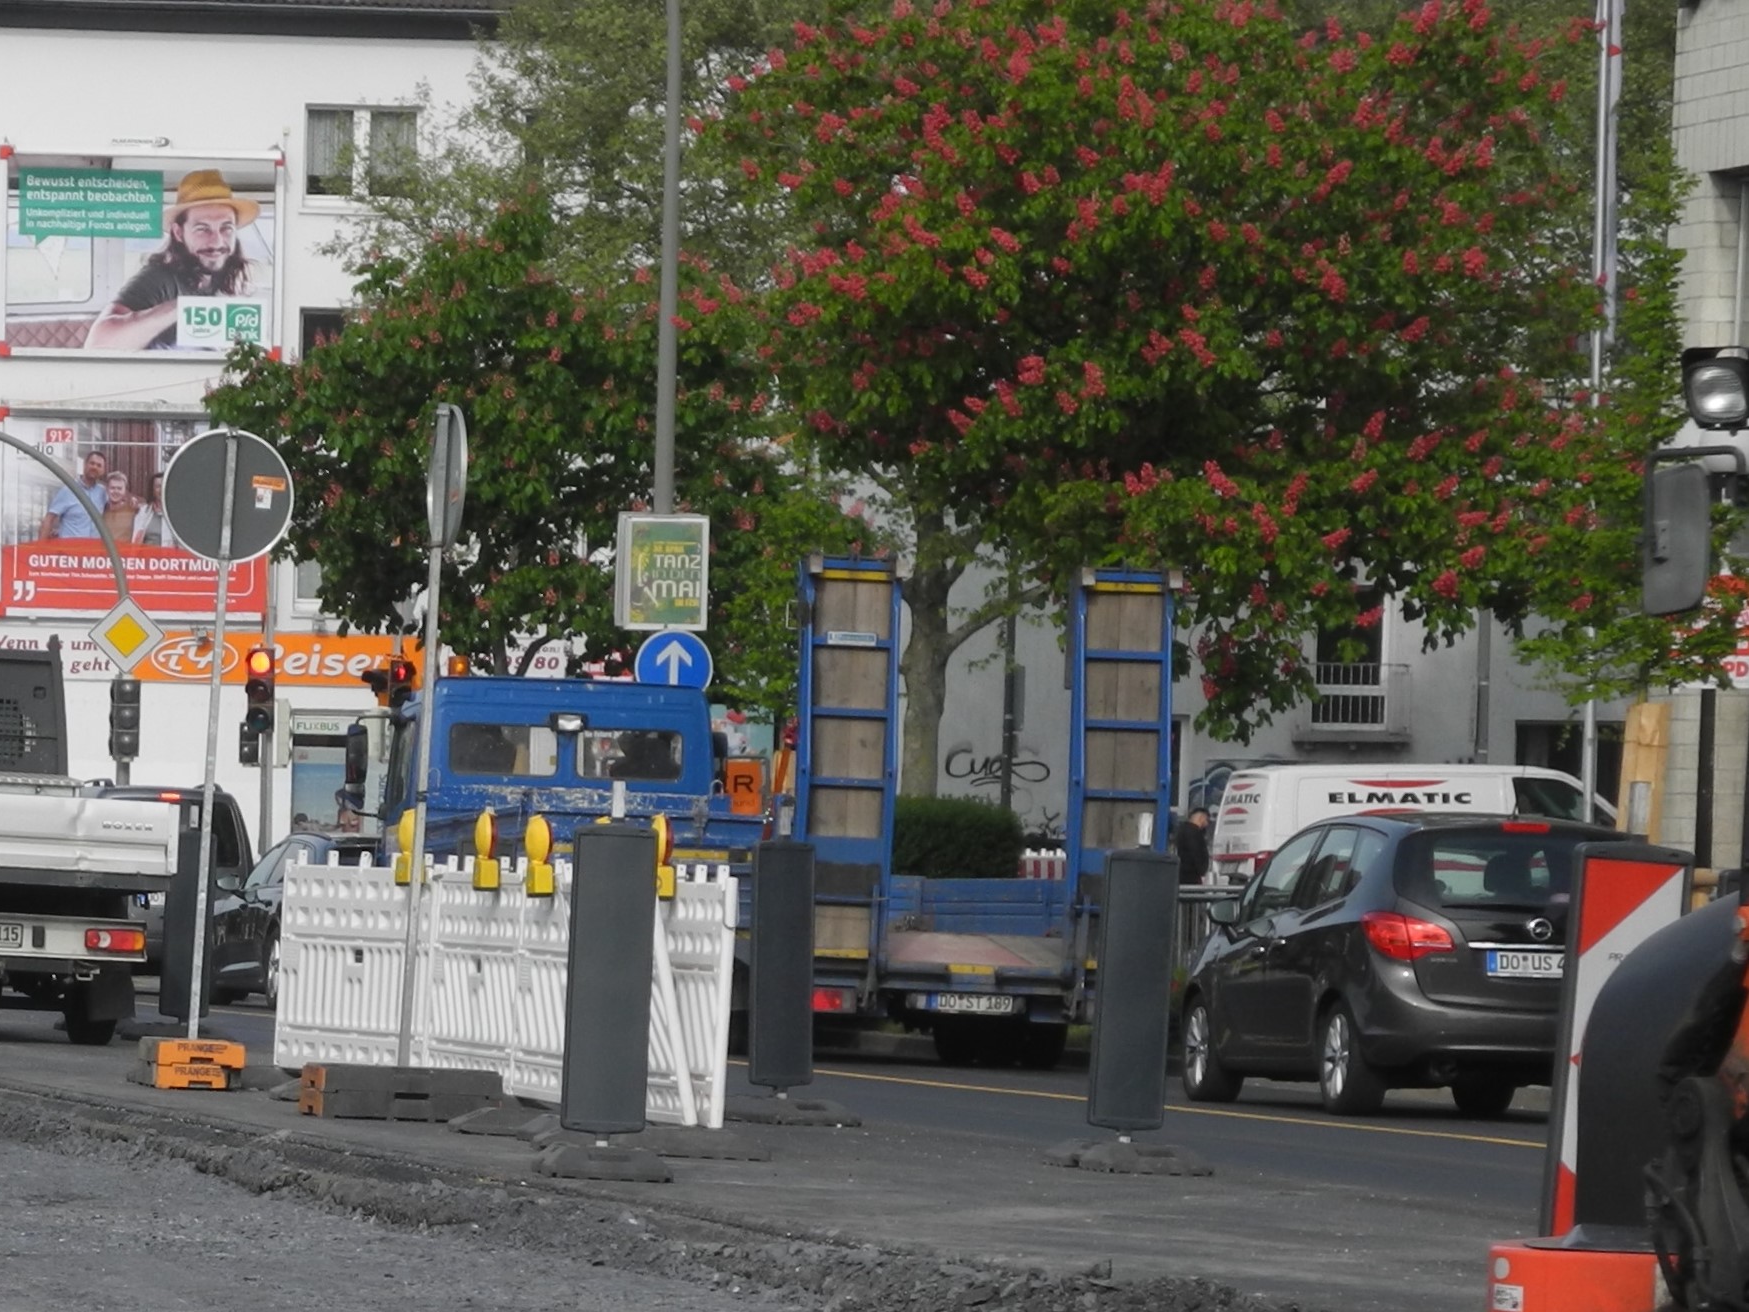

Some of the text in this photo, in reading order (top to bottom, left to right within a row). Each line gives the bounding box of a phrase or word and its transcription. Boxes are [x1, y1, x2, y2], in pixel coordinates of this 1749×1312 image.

[26, 174, 150, 190] Bewusst entscheiden,
[26, 188, 156, 203] entspannt beobachten.
[183, 306, 223, 327] 150
[28, 554, 78, 568] GUTEN
[654, 554, 701, 569] TANZ
[651, 580, 700, 598] MAI
[69, 657, 110, 674] geht
[534, 656, 559, 670] 80
[296, 721, 340, 731] FLIXBUS
[1328, 792, 1472, 805] ELMATIC
[102, 820, 154, 832] BOXER
[1499, 954, 1520, 970] DO
[1531, 955, 1552, 971] US
[939, 994, 1010, 1011] DO ST 189
